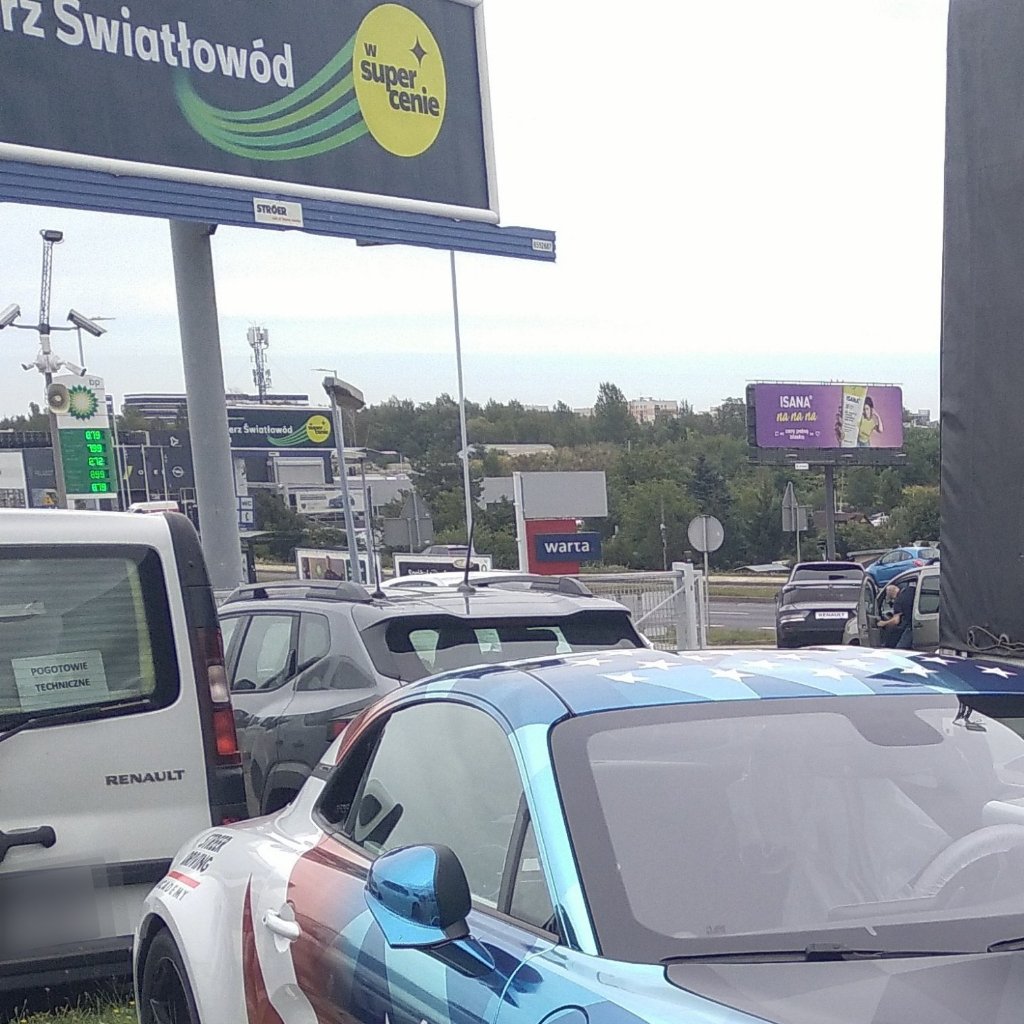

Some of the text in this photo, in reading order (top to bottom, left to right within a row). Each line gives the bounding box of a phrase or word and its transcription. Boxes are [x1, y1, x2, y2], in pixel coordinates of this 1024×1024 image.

[363, 42, 377, 57] w
[360, 60, 417, 92] super
[389, 86, 440, 117] cenie
[776, 411, 818, 422] na na na
[543, 541, 591, 554] warta
[30, 661, 89, 677] POGOTOWIE
[34, 678, 92, 693] TECHNICZNE
[105, 769, 186, 786] RENAULT
[156, 879, 190, 901] CADEMY
